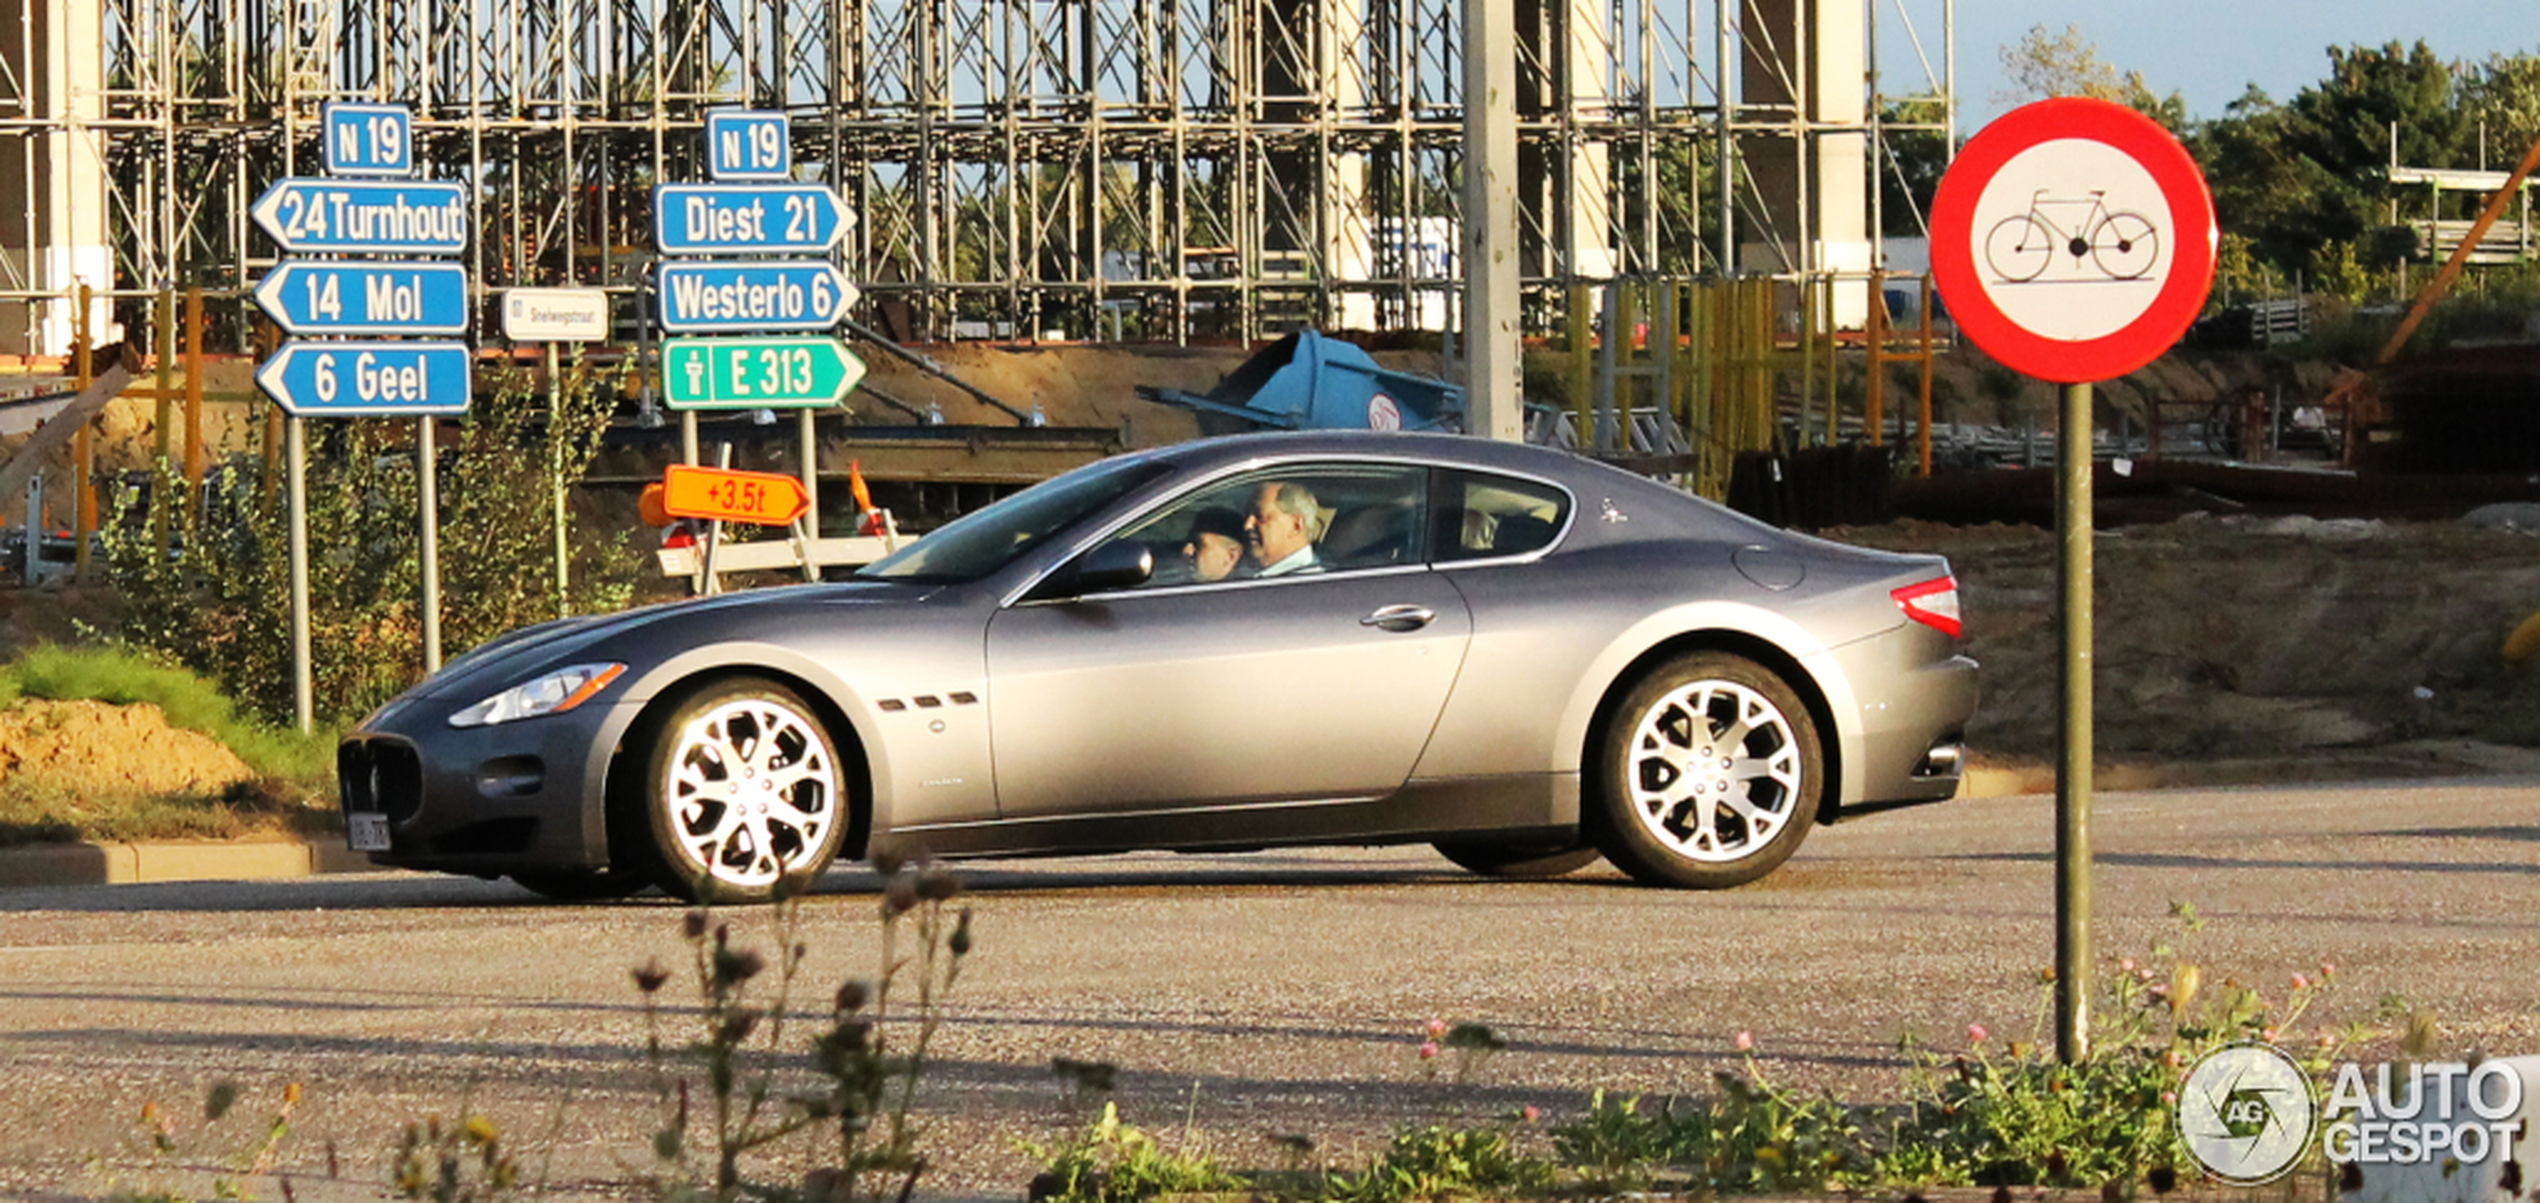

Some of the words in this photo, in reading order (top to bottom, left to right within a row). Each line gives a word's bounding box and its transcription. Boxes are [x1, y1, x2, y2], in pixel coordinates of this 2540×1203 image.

[338, 122, 359, 163] N
[367, 116, 402, 165] 19
[722, 130, 742, 169] N
[748, 122, 780, 169] 19
[283, 190, 328, 239] 24
[329, 191, 463, 241] Turnhout
[686, 195, 766, 242] Diest
[784, 194, 818, 241] 21
[306, 272, 342, 321] 14
[366, 273, 423, 321] Mol
[672, 273, 804, 320] Westerlo
[811, 271, 832, 318] 6
[315, 352, 337, 402] 6
[356, 351, 429, 402] Geel
[731, 349, 751, 395] E
[759, 347, 813, 395] 313
